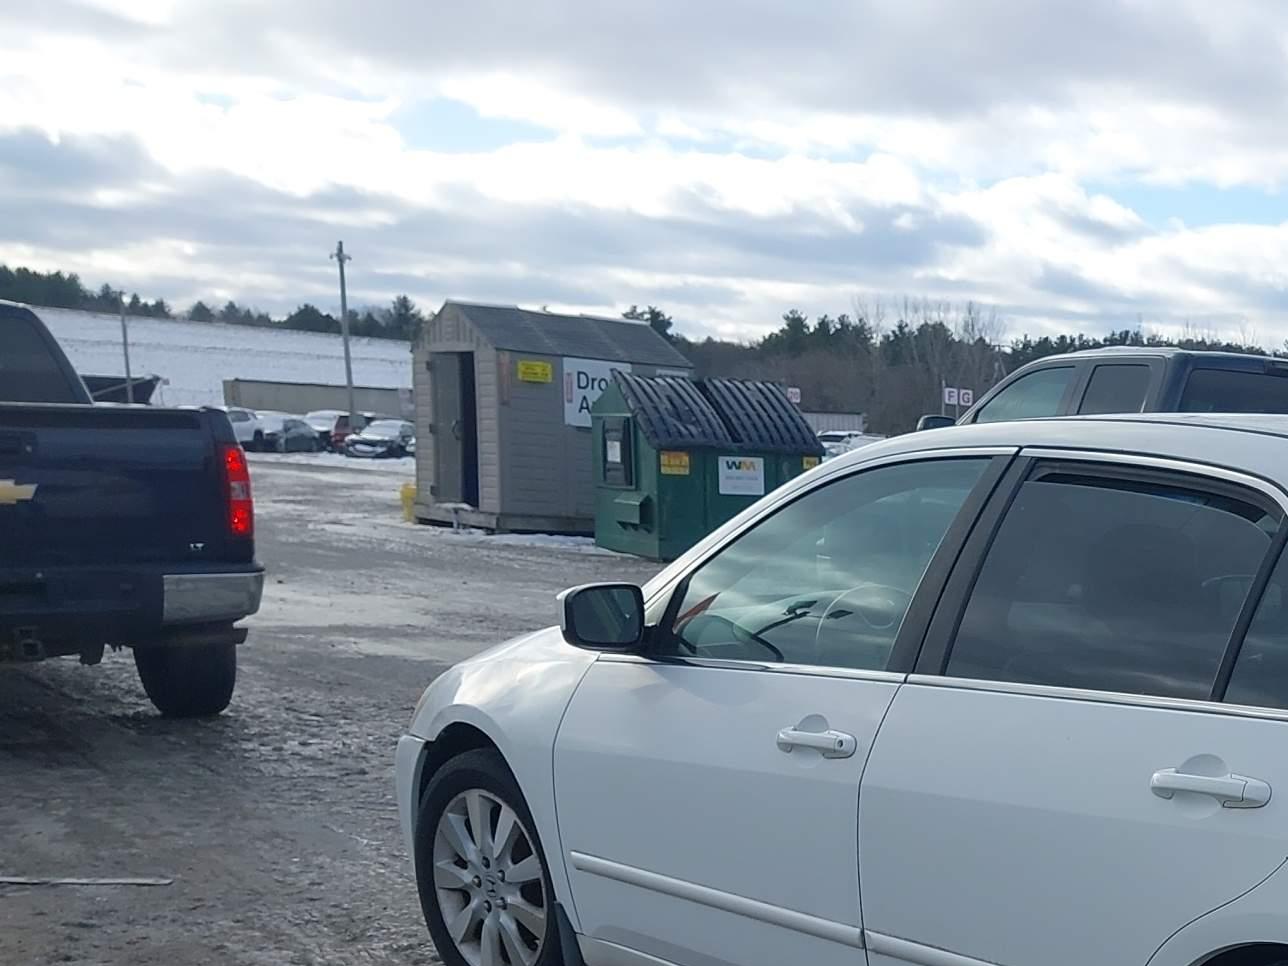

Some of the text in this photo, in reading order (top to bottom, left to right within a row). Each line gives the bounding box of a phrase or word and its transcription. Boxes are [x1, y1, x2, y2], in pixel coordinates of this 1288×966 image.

[577, 371, 612, 391] Dro
[947, 390, 956, 401] F
[962, 391, 970, 403] G
[725, 460, 756, 471] WM
